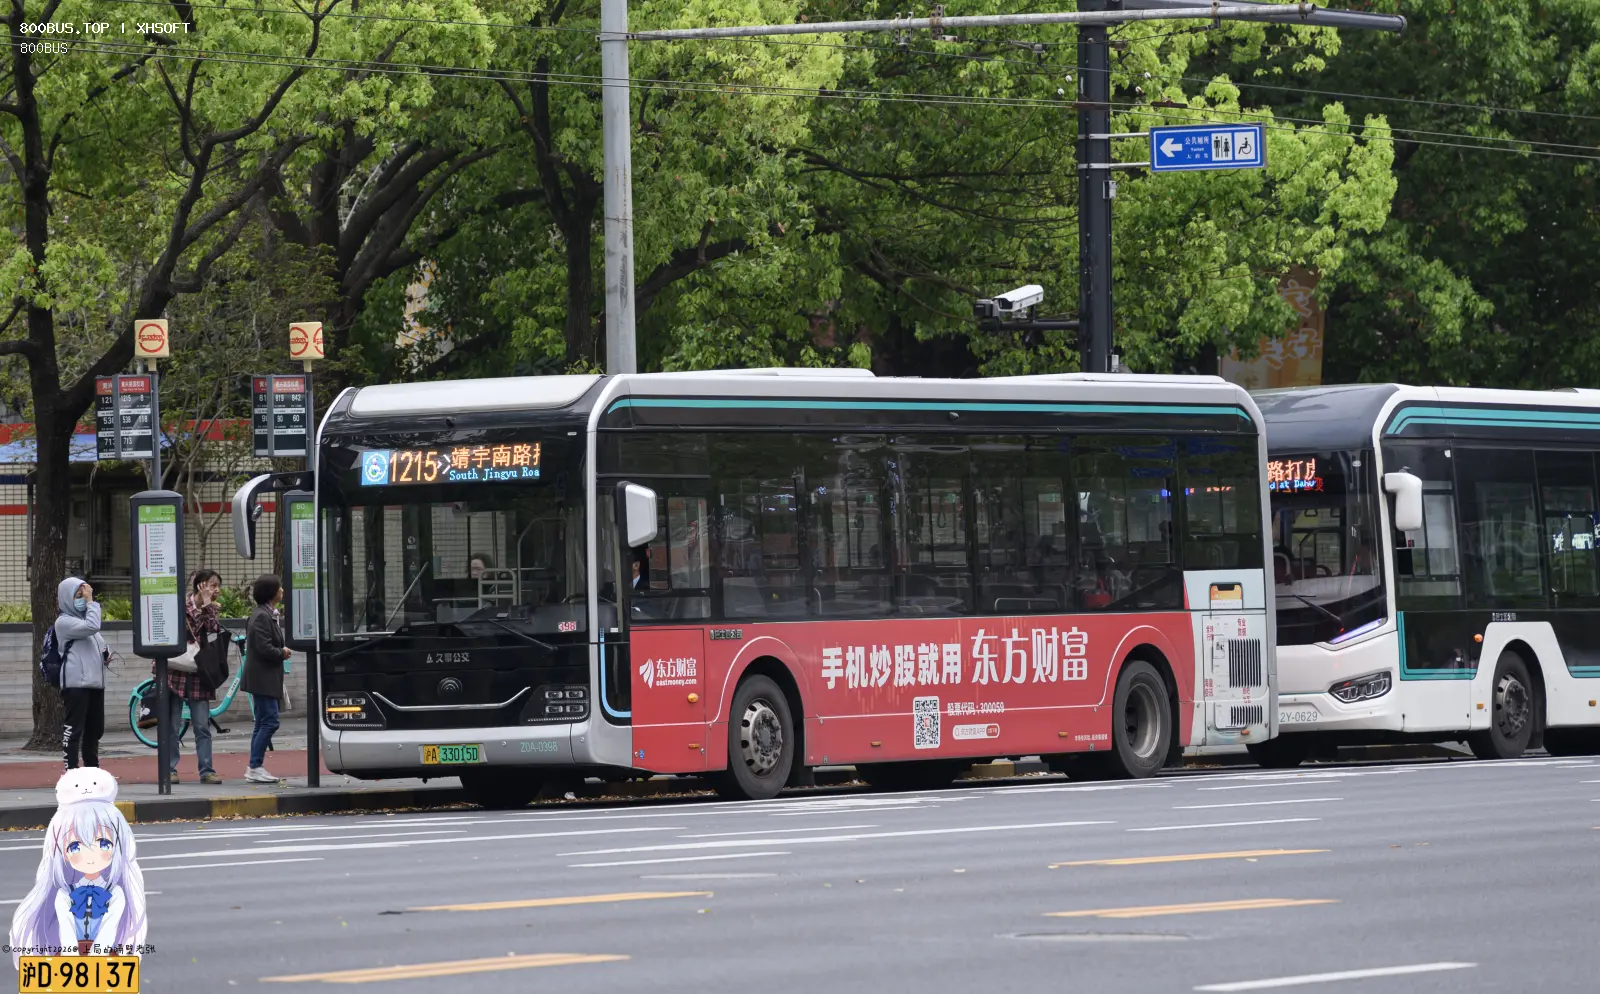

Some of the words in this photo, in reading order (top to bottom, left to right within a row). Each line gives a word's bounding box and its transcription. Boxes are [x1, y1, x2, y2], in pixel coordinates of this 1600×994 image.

[389, 450, 438, 482] 1215
[450, 471, 479, 481] South
[482, 468, 518, 482] Jingyu
[522, 467, 540, 477] Roa
[558, 621, 576, 632] 398
[656, 657, 697, 678] 东方财富
[821, 643, 962, 690] 手机炒股就用
[970, 626, 1089, 686] 东方财富
[655, 678, 697, 687] eastmoney.com
[62, 724, 73, 748] NIKE
